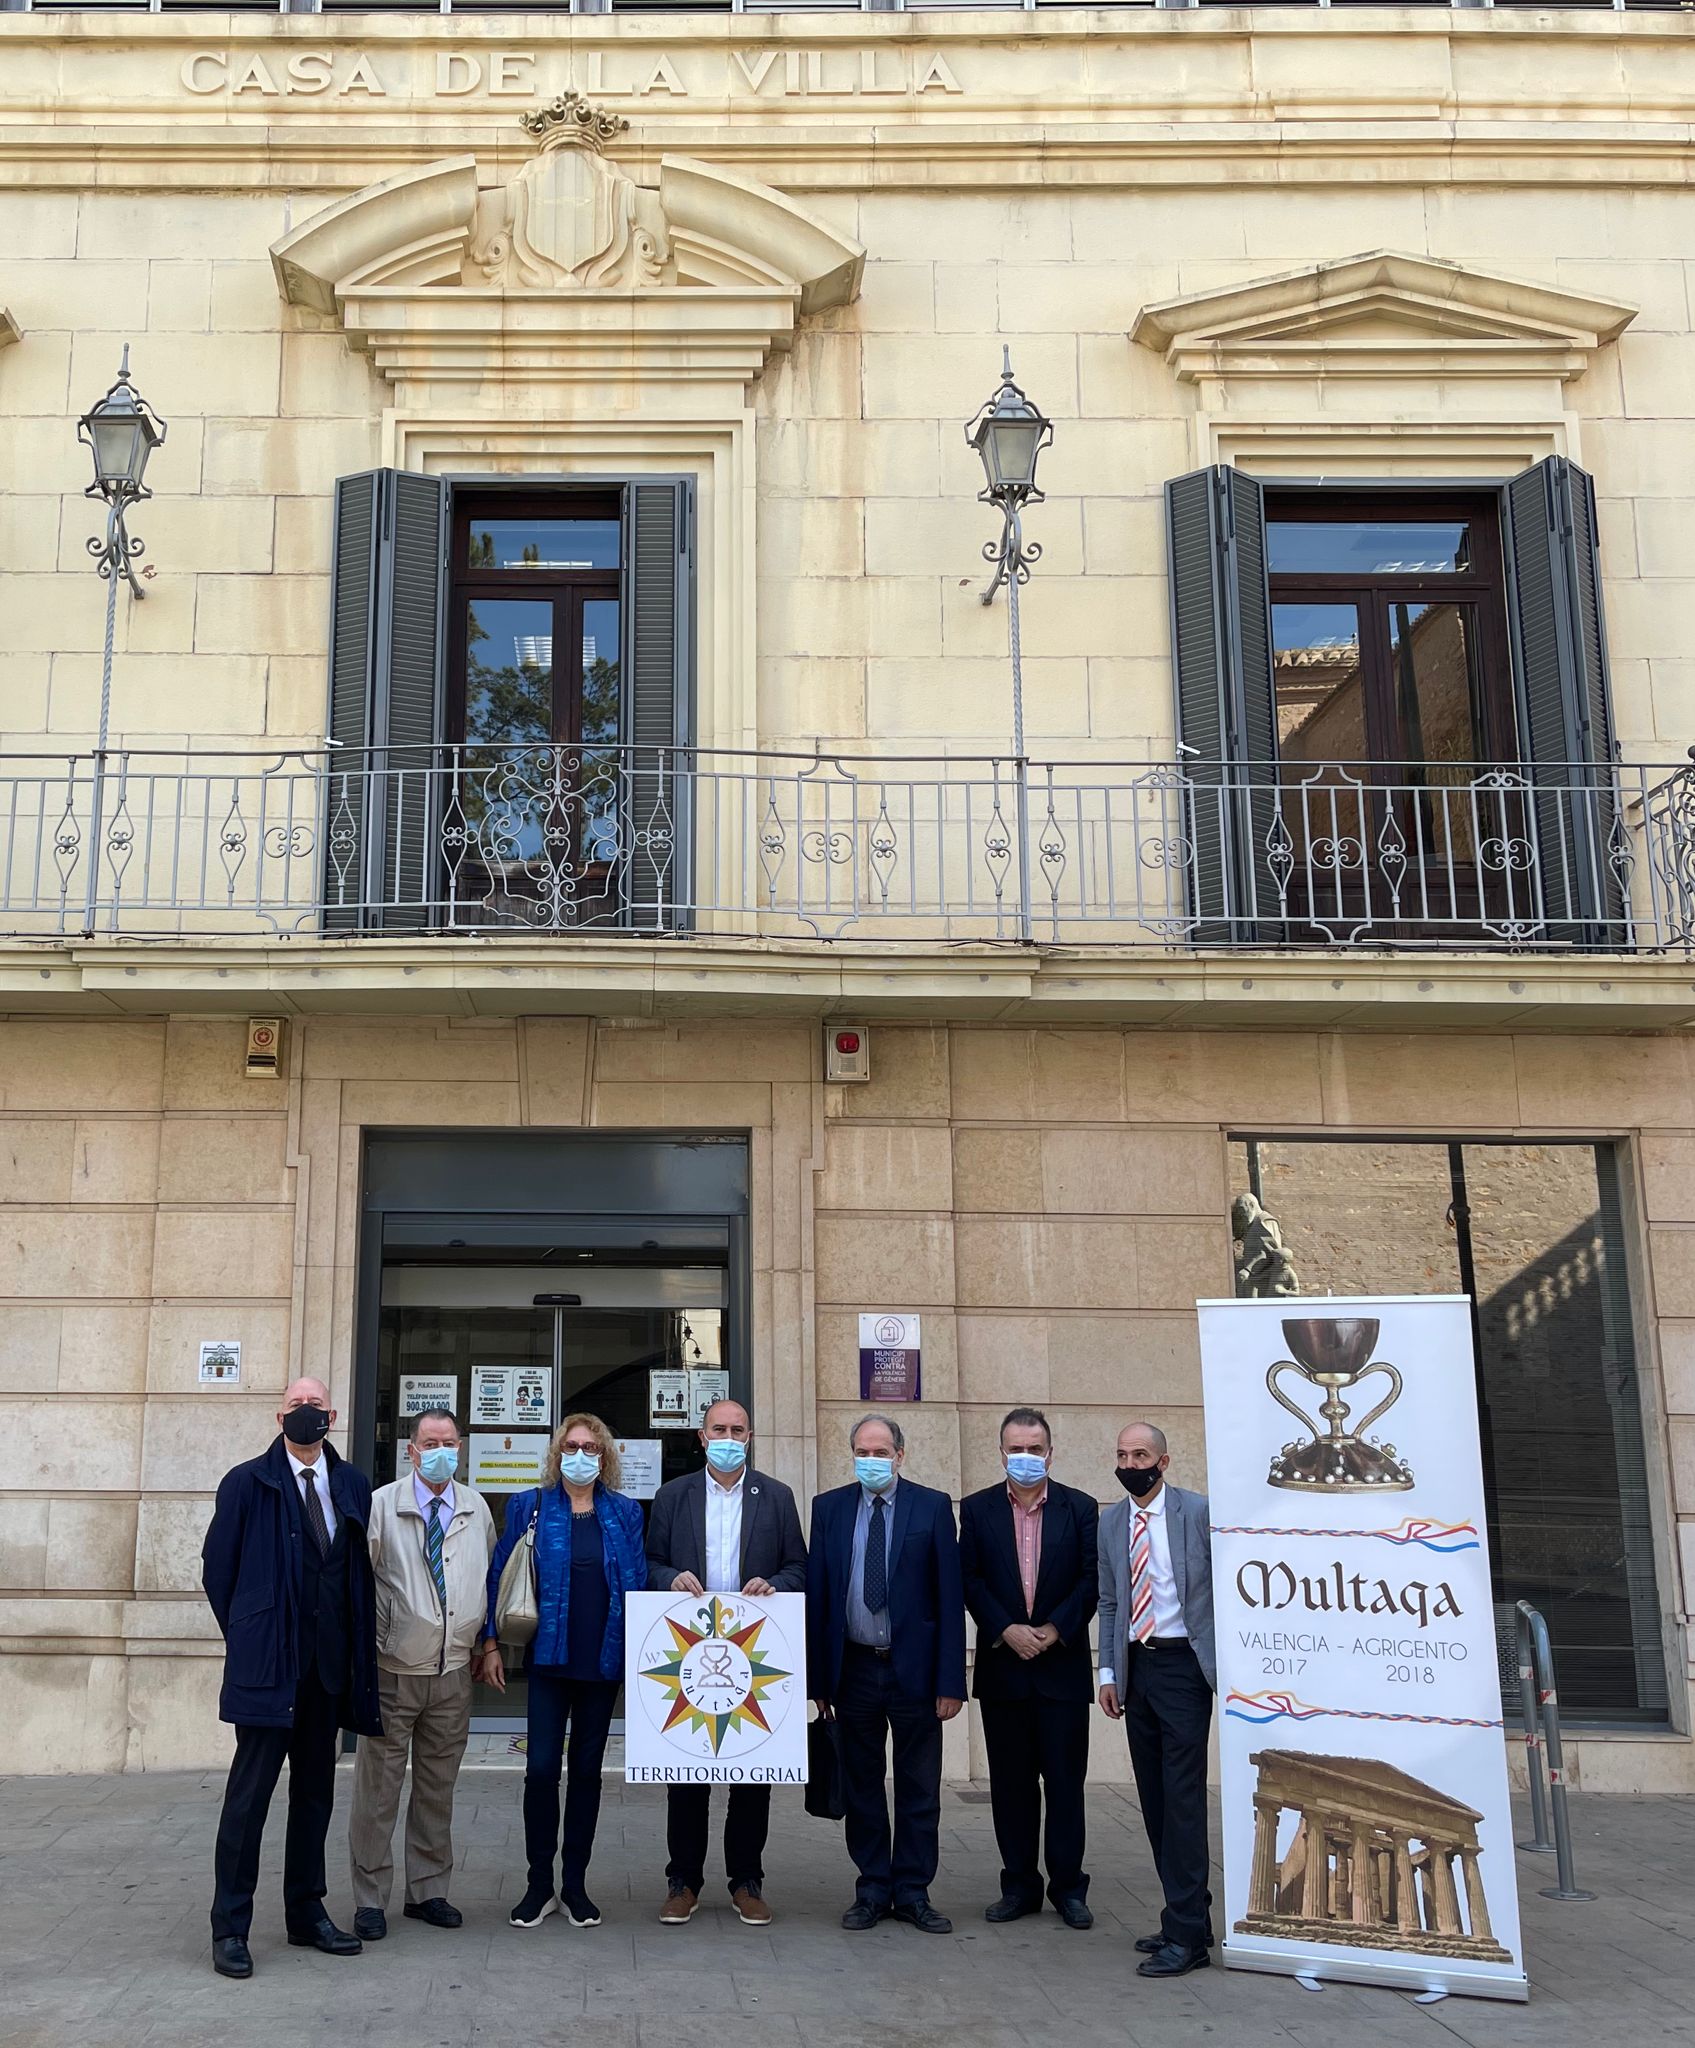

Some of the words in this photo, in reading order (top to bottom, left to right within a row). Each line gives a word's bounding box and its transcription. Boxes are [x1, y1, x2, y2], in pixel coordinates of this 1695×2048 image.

[180, 50, 386, 96] CASA
[435, 51, 536, 96] DE
[587, 50, 688, 95] LA
[732, 50, 964, 95] VILLA
[874, 1362, 906, 1370] CONTRA
[406, 1401, 450, 1411] 900.924900
[1236, 1560, 1464, 1628] Multaqa
[1238, 1631, 1330, 1653] VALENCIA
[1352, 1637, 1468, 1661] AGRIGENTO
[645, 1651, 660, 1664] W
[1262, 1657, 1307, 1675] 2017
[1386, 1664, 1435, 1684] 2018
[703, 1740, 710, 1752] S
[628, 1767, 744, 1782] TERRITORIO
[750, 1767, 806, 1782] GRIAL
